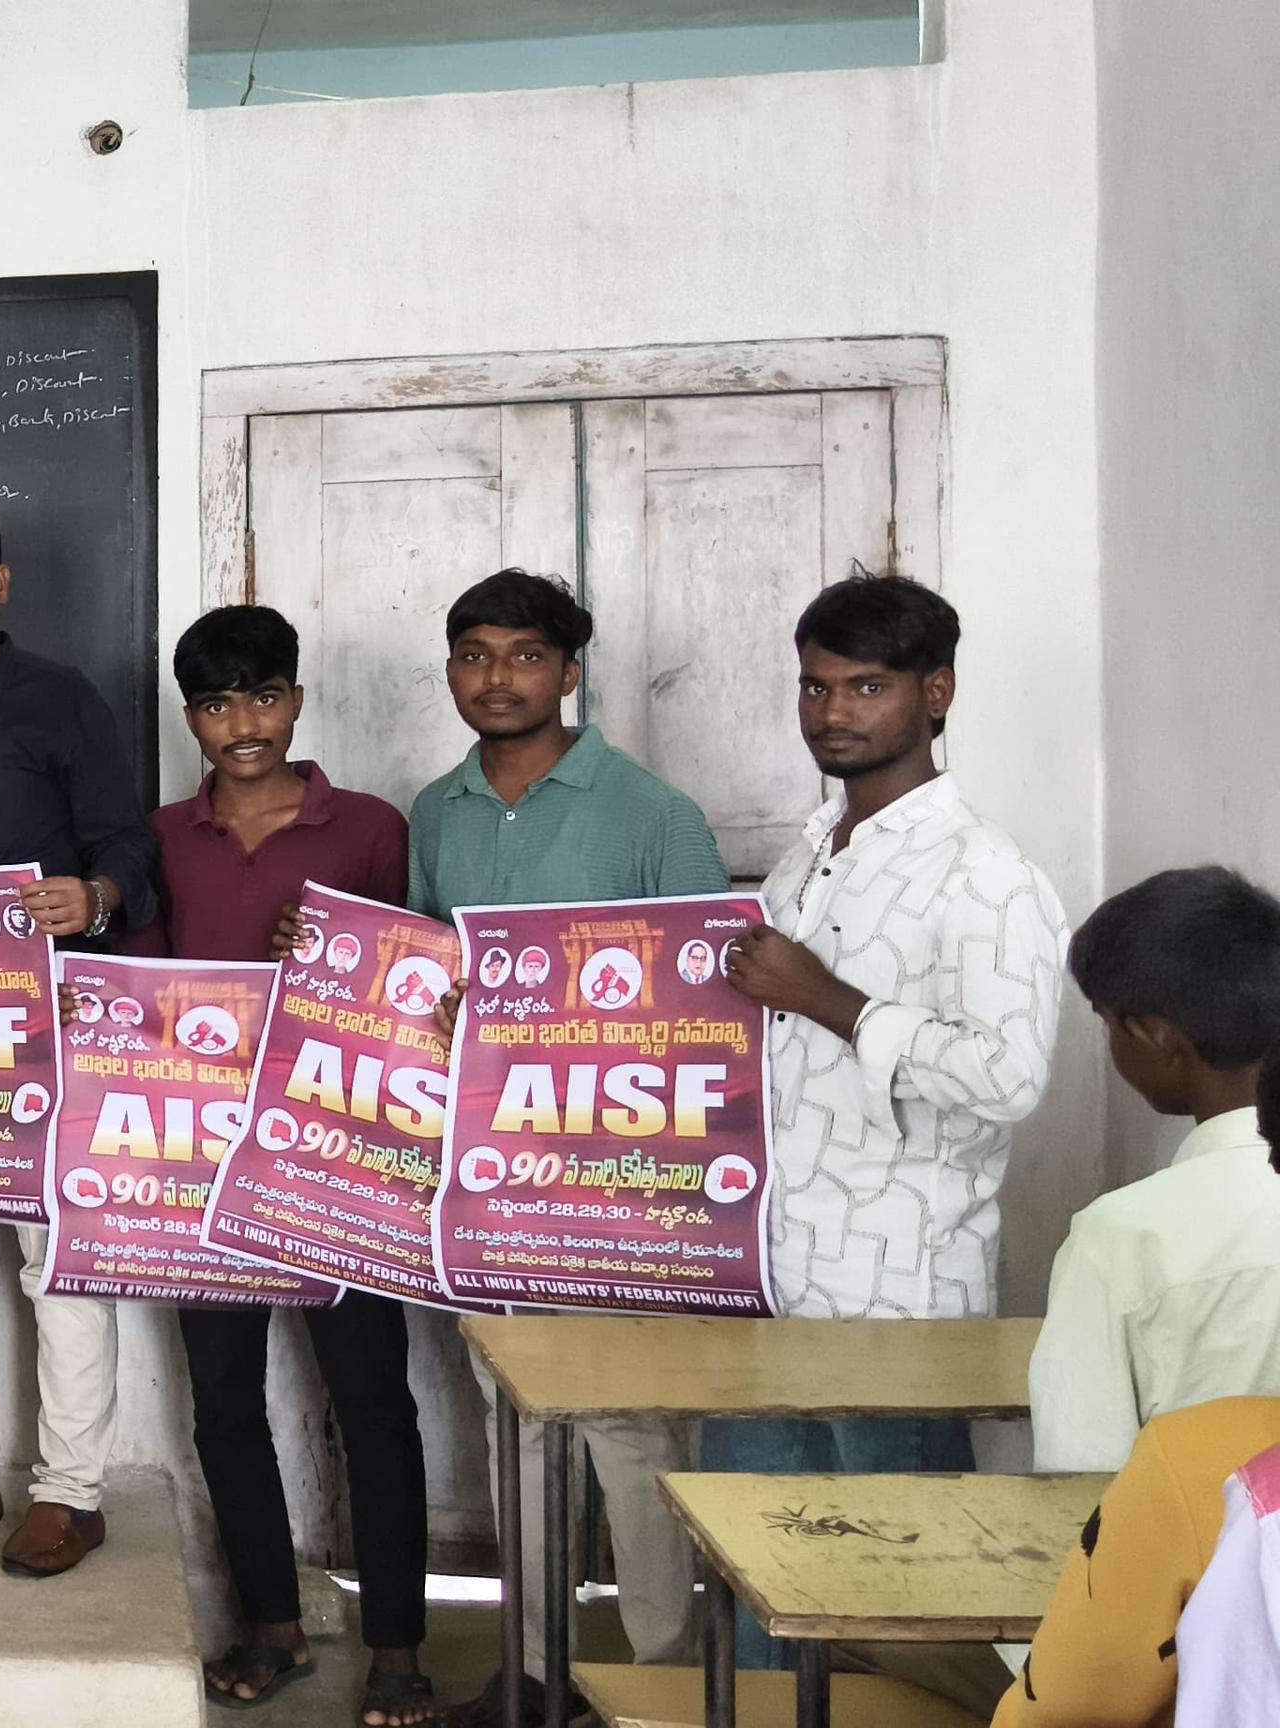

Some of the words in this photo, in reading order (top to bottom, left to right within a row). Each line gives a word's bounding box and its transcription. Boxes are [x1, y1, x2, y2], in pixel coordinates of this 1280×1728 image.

[539, 1021, 598, 1047] భారత
[284, 1038, 448, 1139] AIS
[490, 1063, 727, 1138] AISF
[89, 1091, 246, 1164] AIS
[298, 1122, 348, 1160] 90
[507, 1151, 561, 1188] 90
[111, 1173, 160, 1206] 90
[363, 1262, 441, 1293] FEDERATIO
[454, 1273, 481, 1288] ALL
[484, 1276, 525, 1292] INDIA
